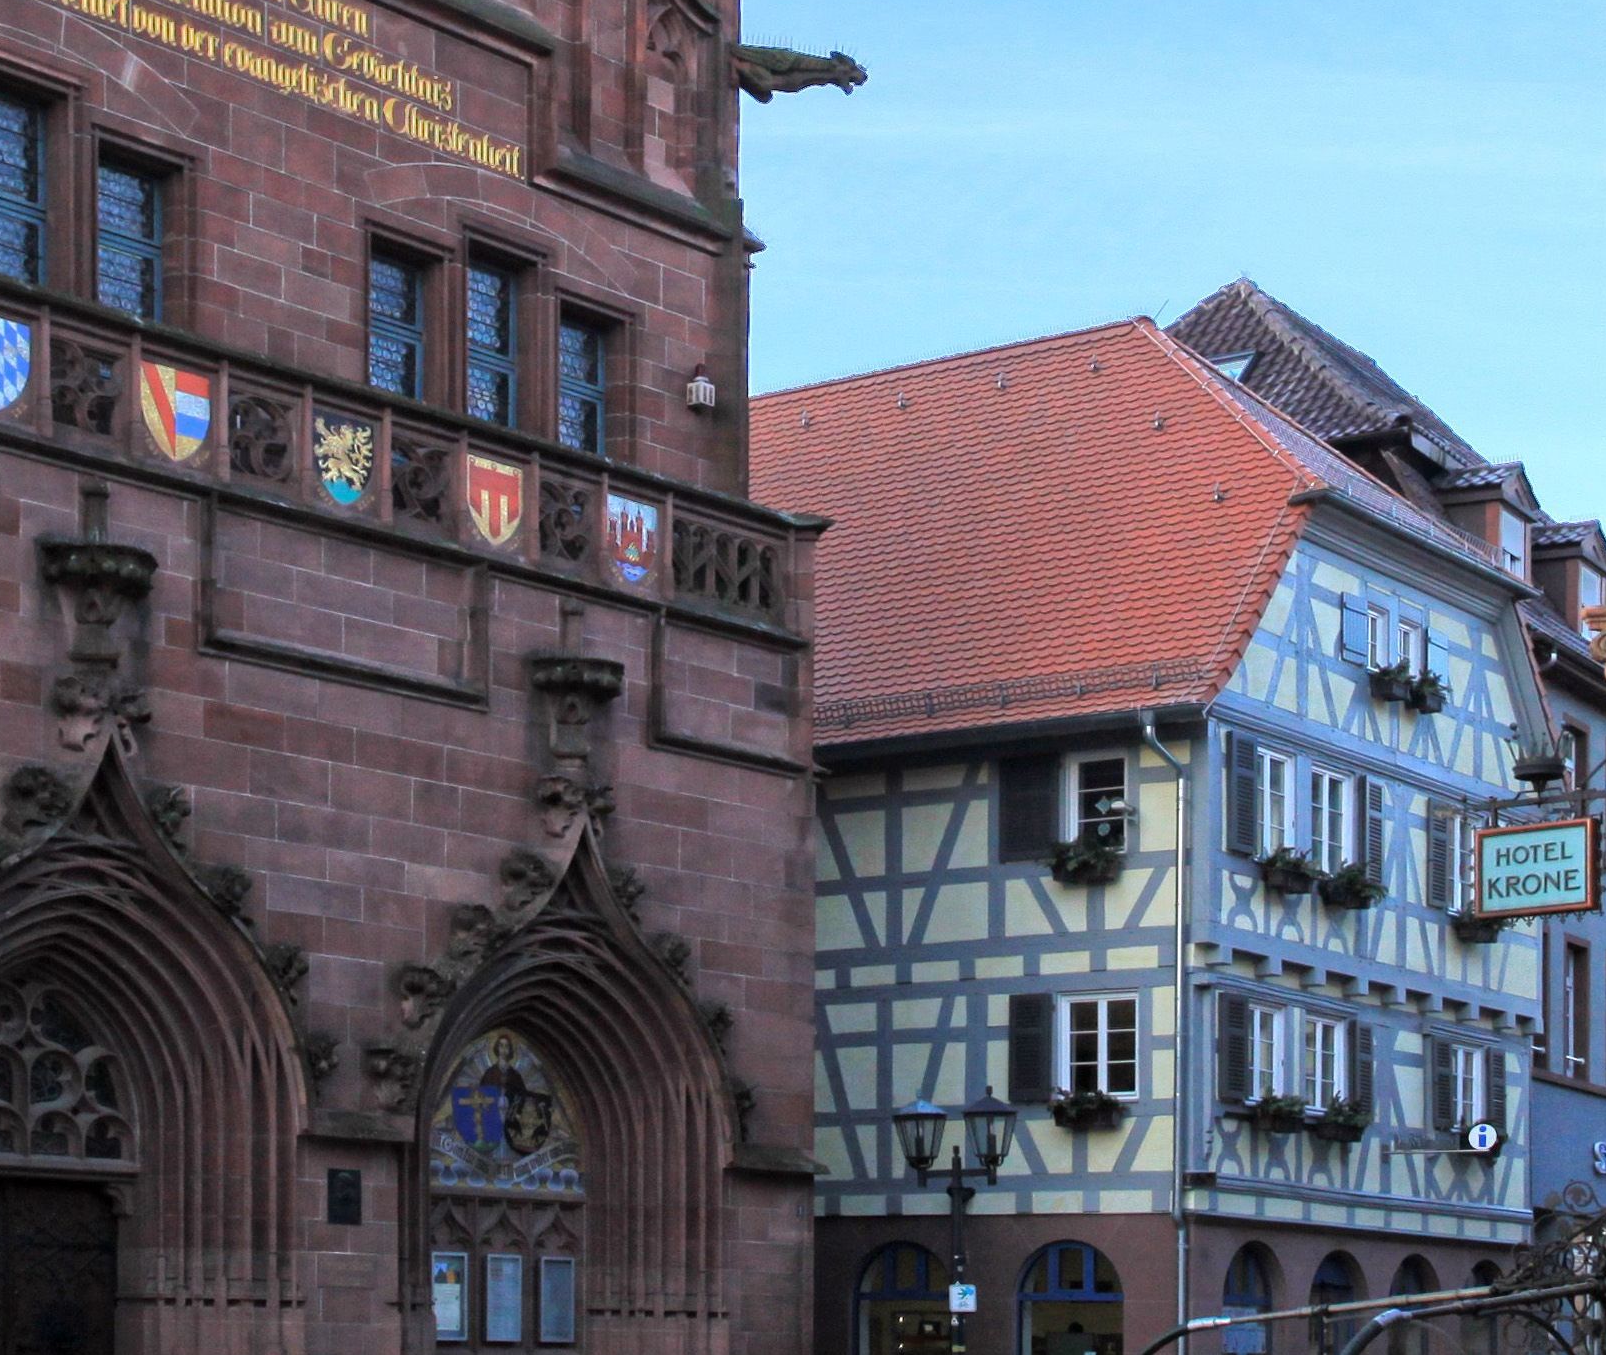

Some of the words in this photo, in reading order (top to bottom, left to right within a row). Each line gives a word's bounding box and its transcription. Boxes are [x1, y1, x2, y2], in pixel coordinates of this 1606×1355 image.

[133, 4, 177, 47] von
[180, 19, 220, 61] der
[1496, 840, 1573, 867] HOTEL
[1487, 868, 1581, 900] KRONE
